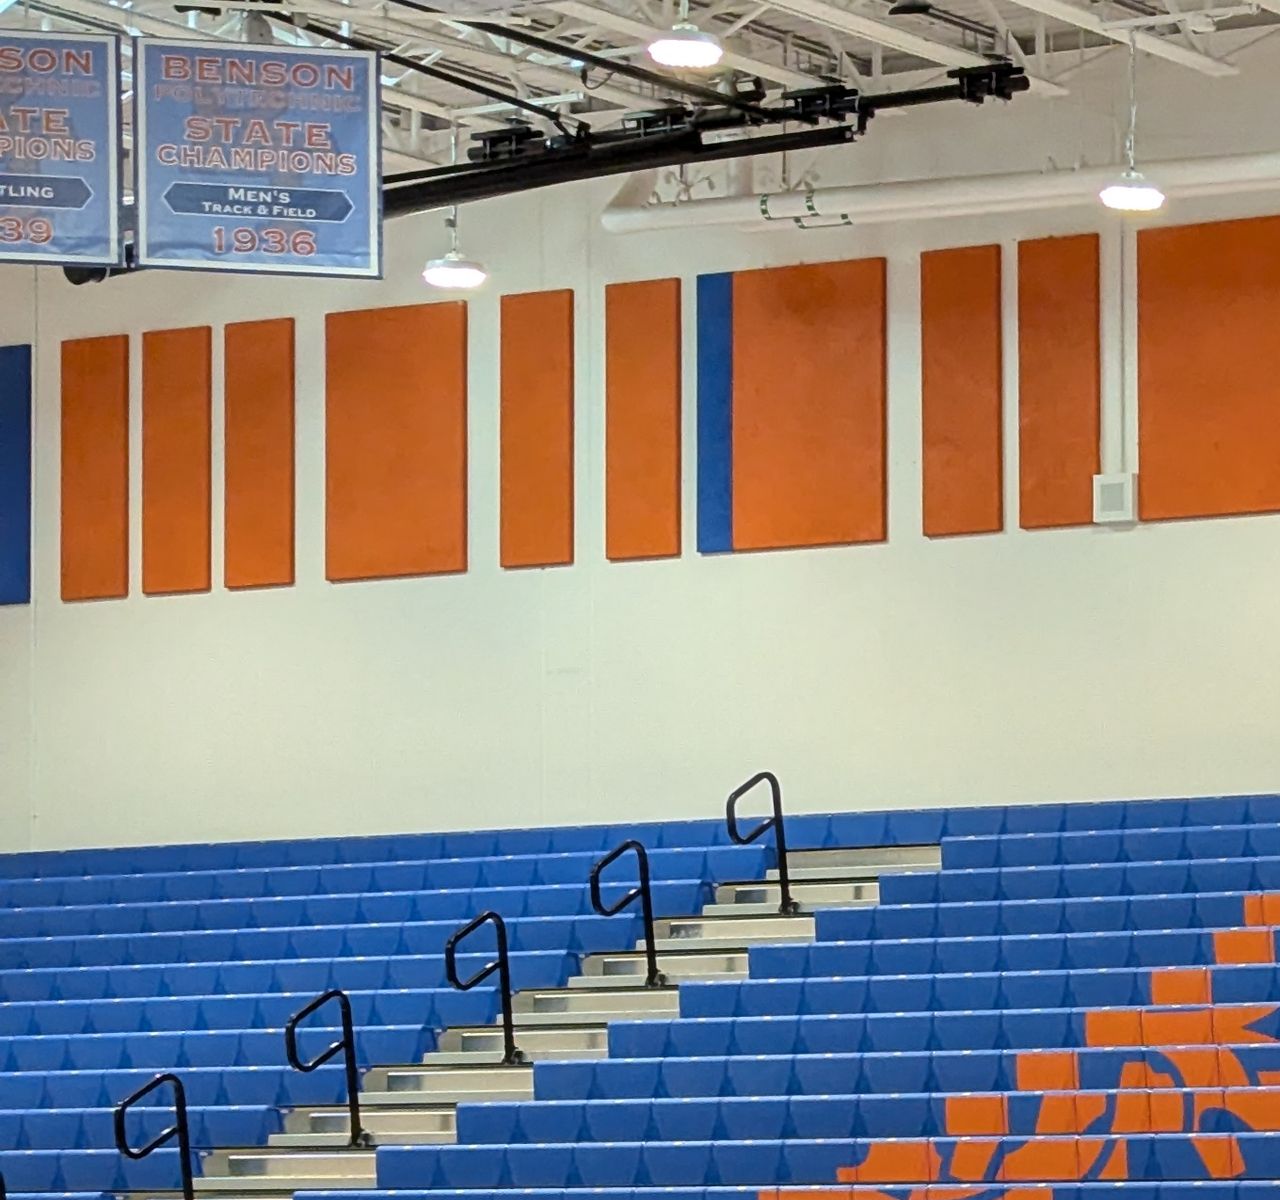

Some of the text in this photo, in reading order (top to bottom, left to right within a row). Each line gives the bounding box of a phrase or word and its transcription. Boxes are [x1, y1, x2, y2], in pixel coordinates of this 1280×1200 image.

[162, 55, 354, 91] BENSON
[184, 115, 332, 149] STATE
[157, 143, 357, 175] CHAMPIONS
[257, 203, 270, 216] &
[213, 225, 318, 258] 1936
